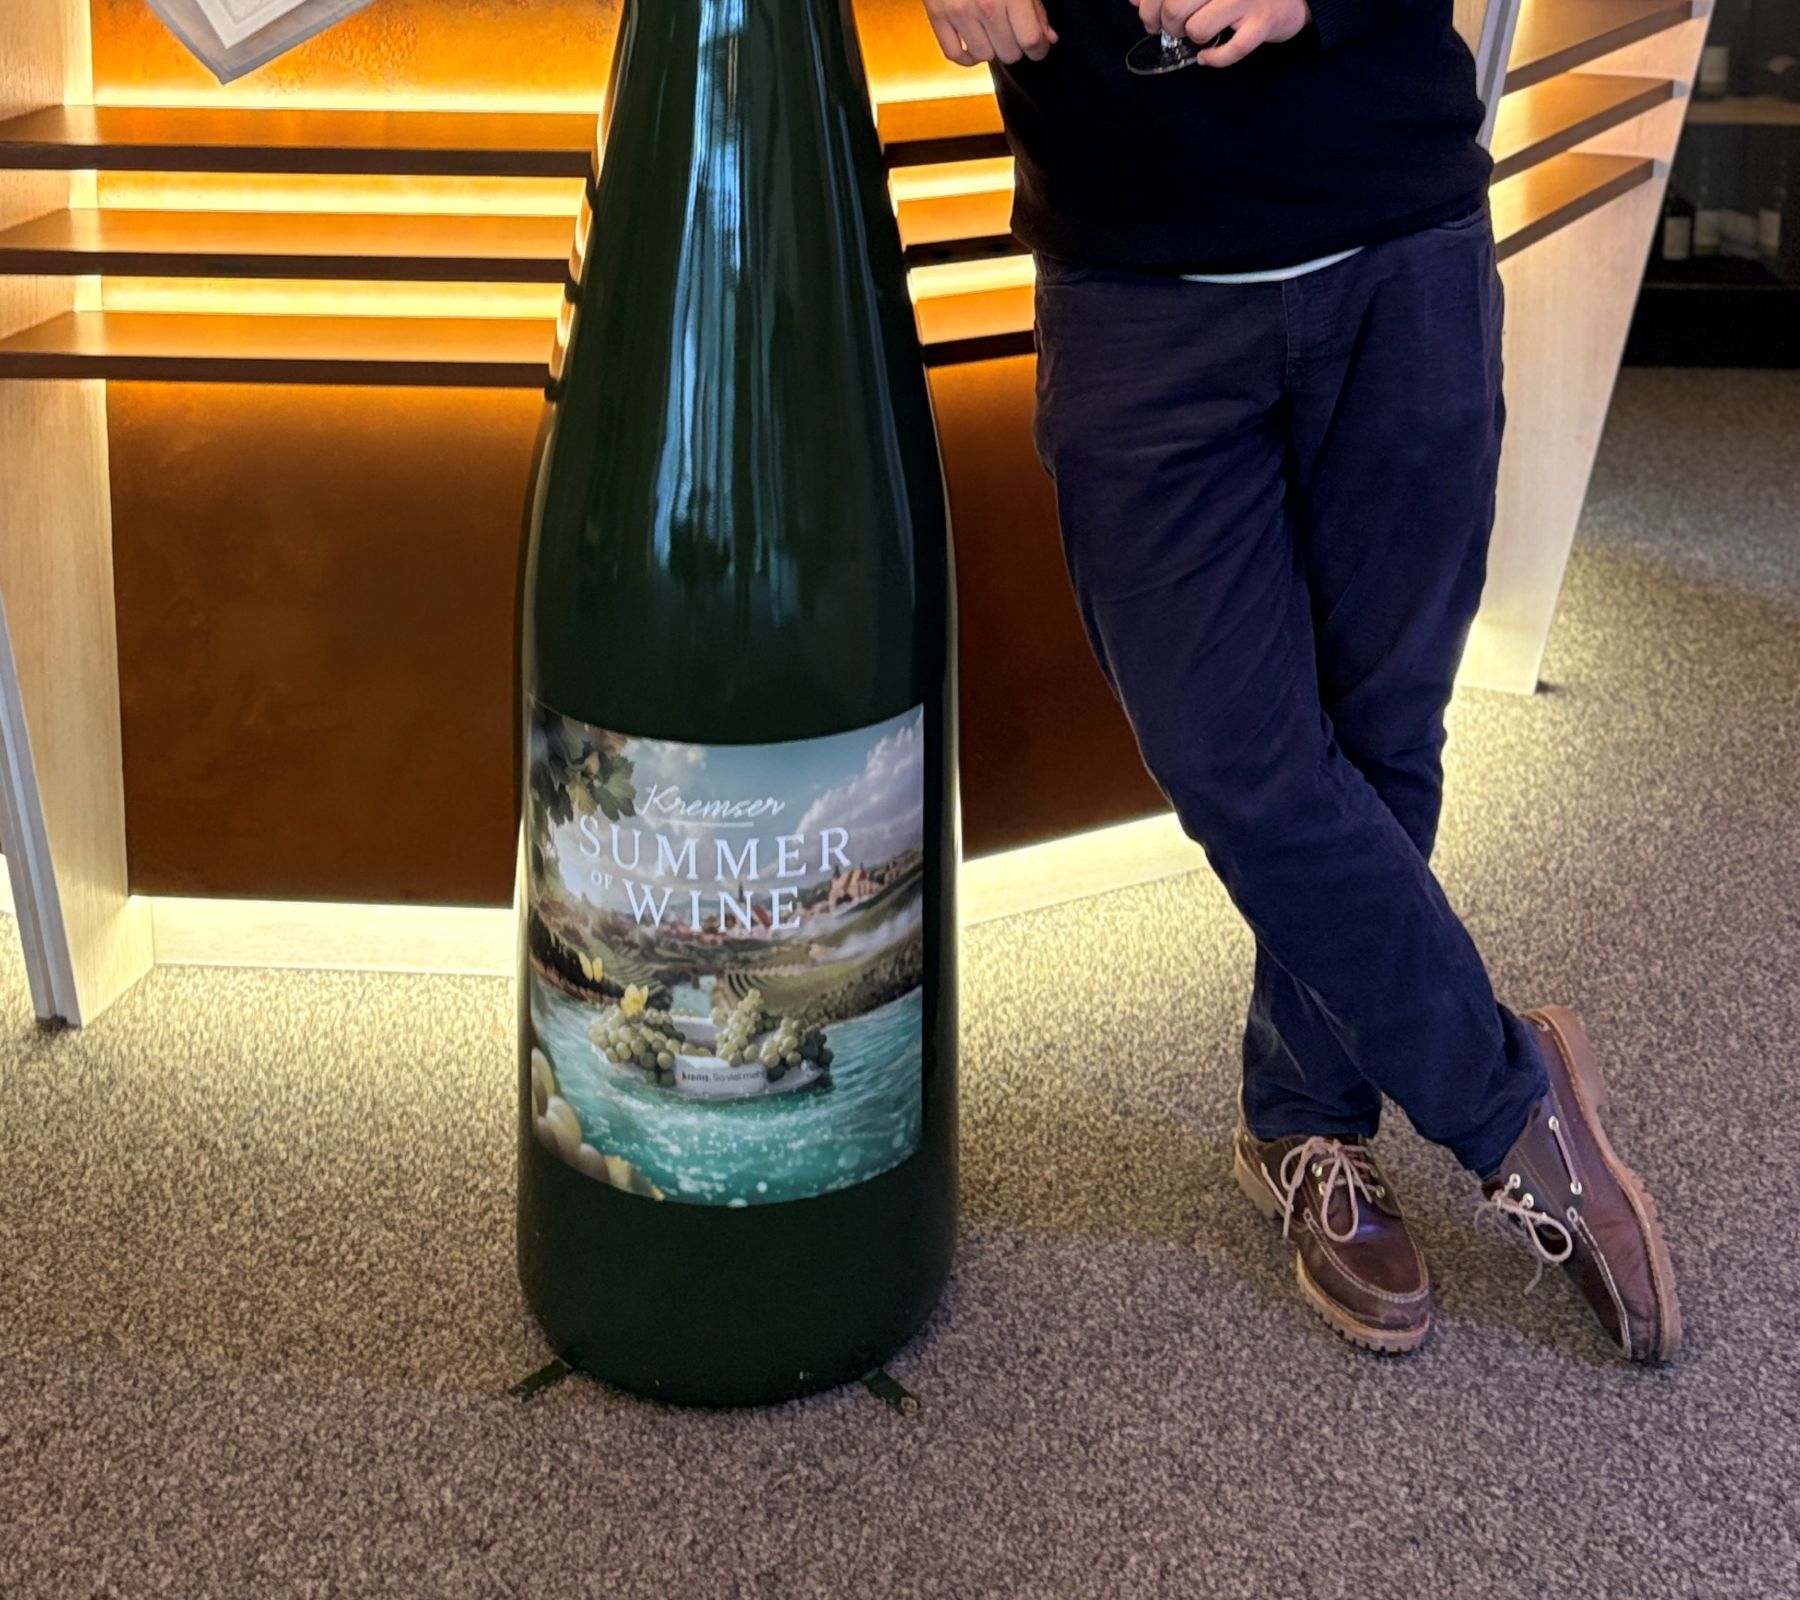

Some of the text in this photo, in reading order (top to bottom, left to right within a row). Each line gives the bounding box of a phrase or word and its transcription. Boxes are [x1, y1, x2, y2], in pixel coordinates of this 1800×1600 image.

[636, 784, 786, 818] Kremser
[579, 814, 851, 881] SUMMER
[590, 871, 801, 932] OF WINE
